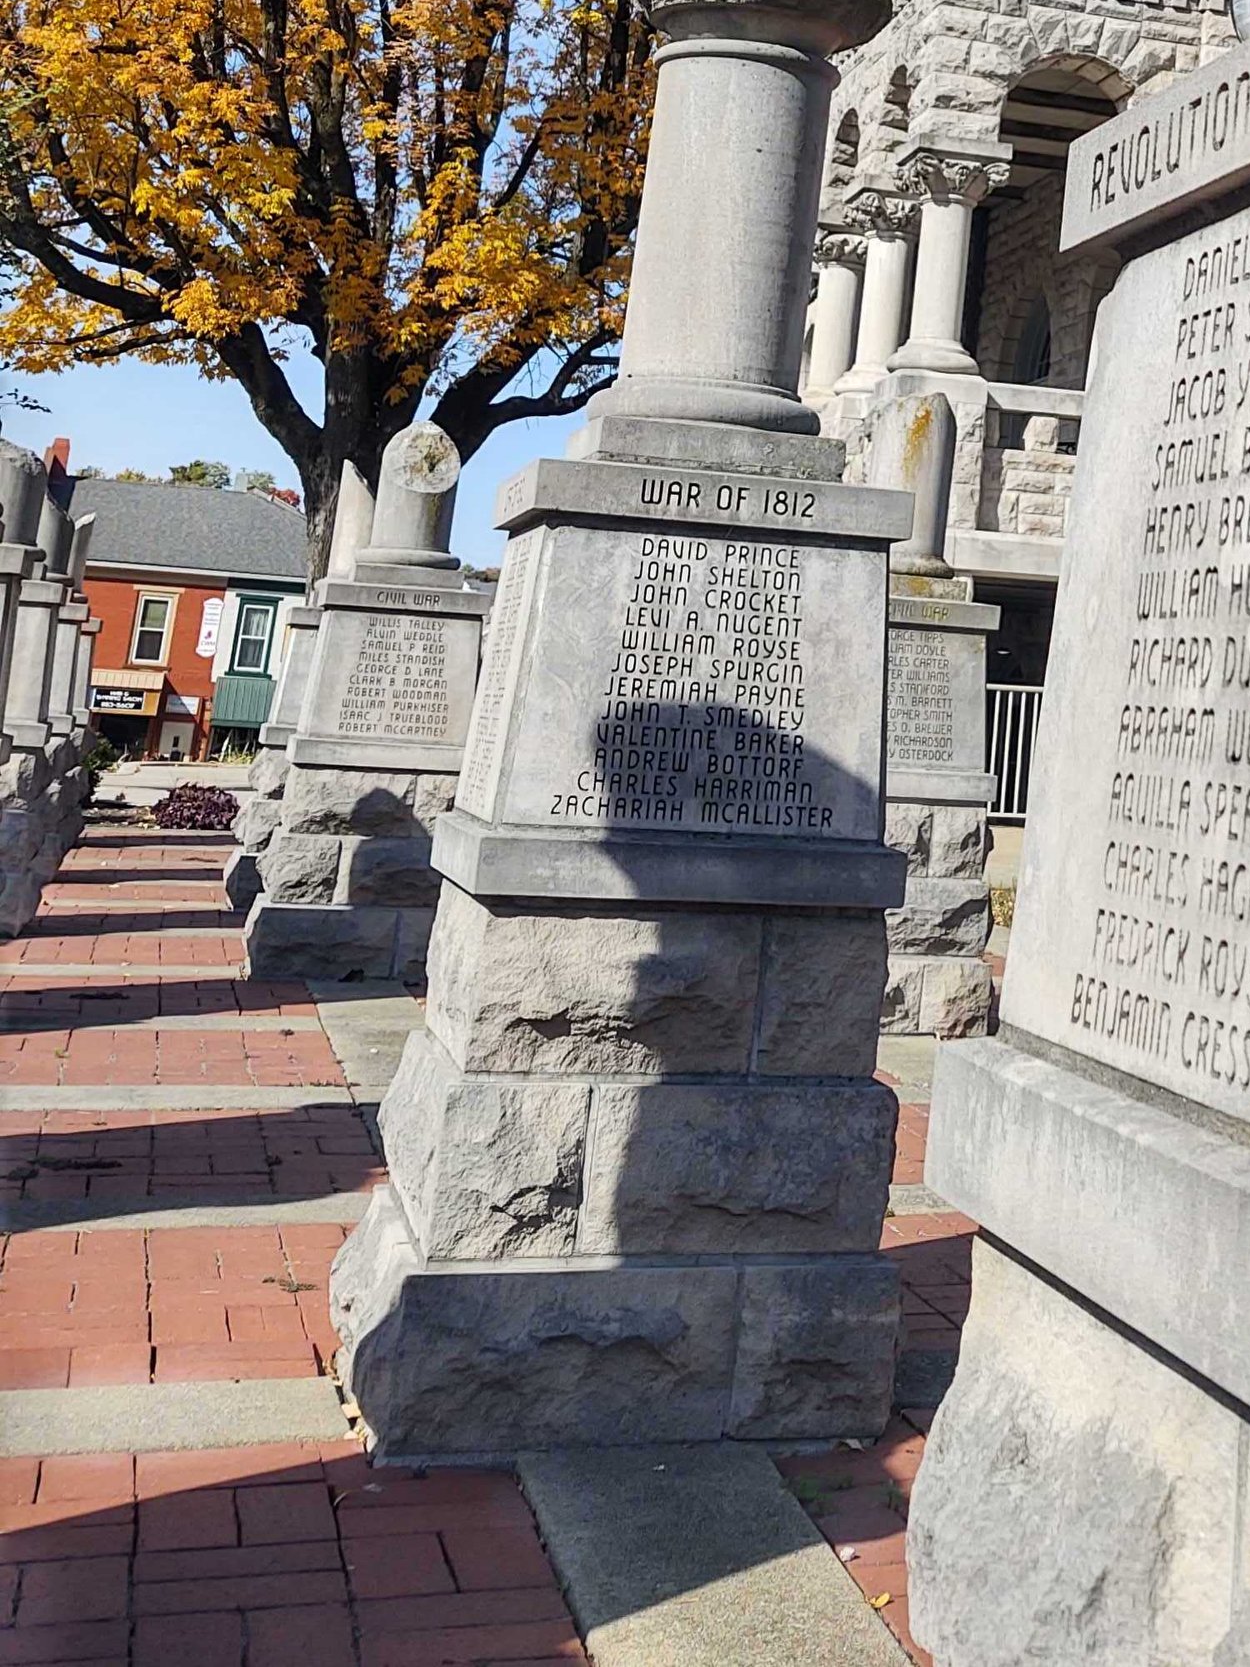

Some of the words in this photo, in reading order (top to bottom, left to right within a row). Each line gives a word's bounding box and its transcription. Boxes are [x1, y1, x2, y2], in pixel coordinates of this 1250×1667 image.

[1176, 301, 1235, 363] PETER
[1164, 368, 1226, 428] JACOB
[1152, 433, 1229, 493] SAMUEL
[641, 478, 700, 508] WAR
[717, 484, 750, 511] OF
[764, 489, 816, 518] 1812
[1143, 499, 1208, 556] HENRY
[642, 537, 708, 561] DAVID
[726, 544, 800, 569] PRINCE
[634, 561, 691, 583] JOHN
[708, 566, 801, 591] SHELTON
[377, 591, 406, 605] CIVIL
[414, 595, 441, 606] WAR
[630, 584, 688, 606] JOHN
[705, 589, 802, 614] CROCKET
[1136, 565, 1219, 622] WILLIAM
[366, 629, 396, 639] ALVIN
[369, 617, 401, 628] WILLIS
[409, 620, 445, 631] TALLEY
[625, 608, 672, 628] LEVI
[717, 615, 802, 637] NUGENT
[359, 652, 389, 662] MILES
[396, 655, 445, 665] STANDISH
[361, 640, 402, 651] SAMUEL
[422, 645, 445, 654] REID
[622, 630, 715, 655] WILLIAM
[734, 639, 801, 661] ROYSE
[916, 645, 946, 656] DOYLE
[356, 664, 397, 675] GEORGE
[419, 668, 444, 678] LANE
[611, 654, 693, 677] JOSEPH
[711, 659, 803, 685] SPURGIN
[906, 671, 950, 682] WILLIAMS
[913, 658, 949, 669] CARTER
[1128, 636, 1213, 689] RICHARD
[347, 687, 386, 697] ROBERT
[392, 689, 447, 700] WOODMAN
[350, 675, 382, 685] CLARK
[403, 678, 448, 689] MORGAN
[604, 677, 717, 702] JEREMIAH
[735, 685, 805, 707] PAYNE
[339, 711, 370, 720] ISAAC
[390, 713, 448, 724] TRUEBLOOD
[342, 698, 386, 709] WILLIAM
[601, 702, 660, 723] JOHN
[704, 707, 804, 731] SMEDLEY
[912, 697, 953, 708] BARNETT
[339, 722, 378, 732] ROBERT
[597, 724, 717, 750] VALENTINE
[734, 731, 805, 754] BAKER
[894, 736, 953, 748] RICHARDSON
[915, 724, 953, 735] BREWER
[1120, 704, 1216, 766] ABRAHAM
[594, 748, 689, 773] ANDREW
[707, 756, 804, 779] BOTTORF
[578, 771, 677, 795] CHARLES
[695, 780, 813, 803] HARRIMAN
[551, 794, 684, 822] ZACHARIAH
[701, 802, 834, 829] MCALLISTER
[1109, 772, 1191, 834] AQUILLA
[1103, 840, 1189, 907] CHARLES
[1070, 973, 1171, 1060] BENJAMIN
